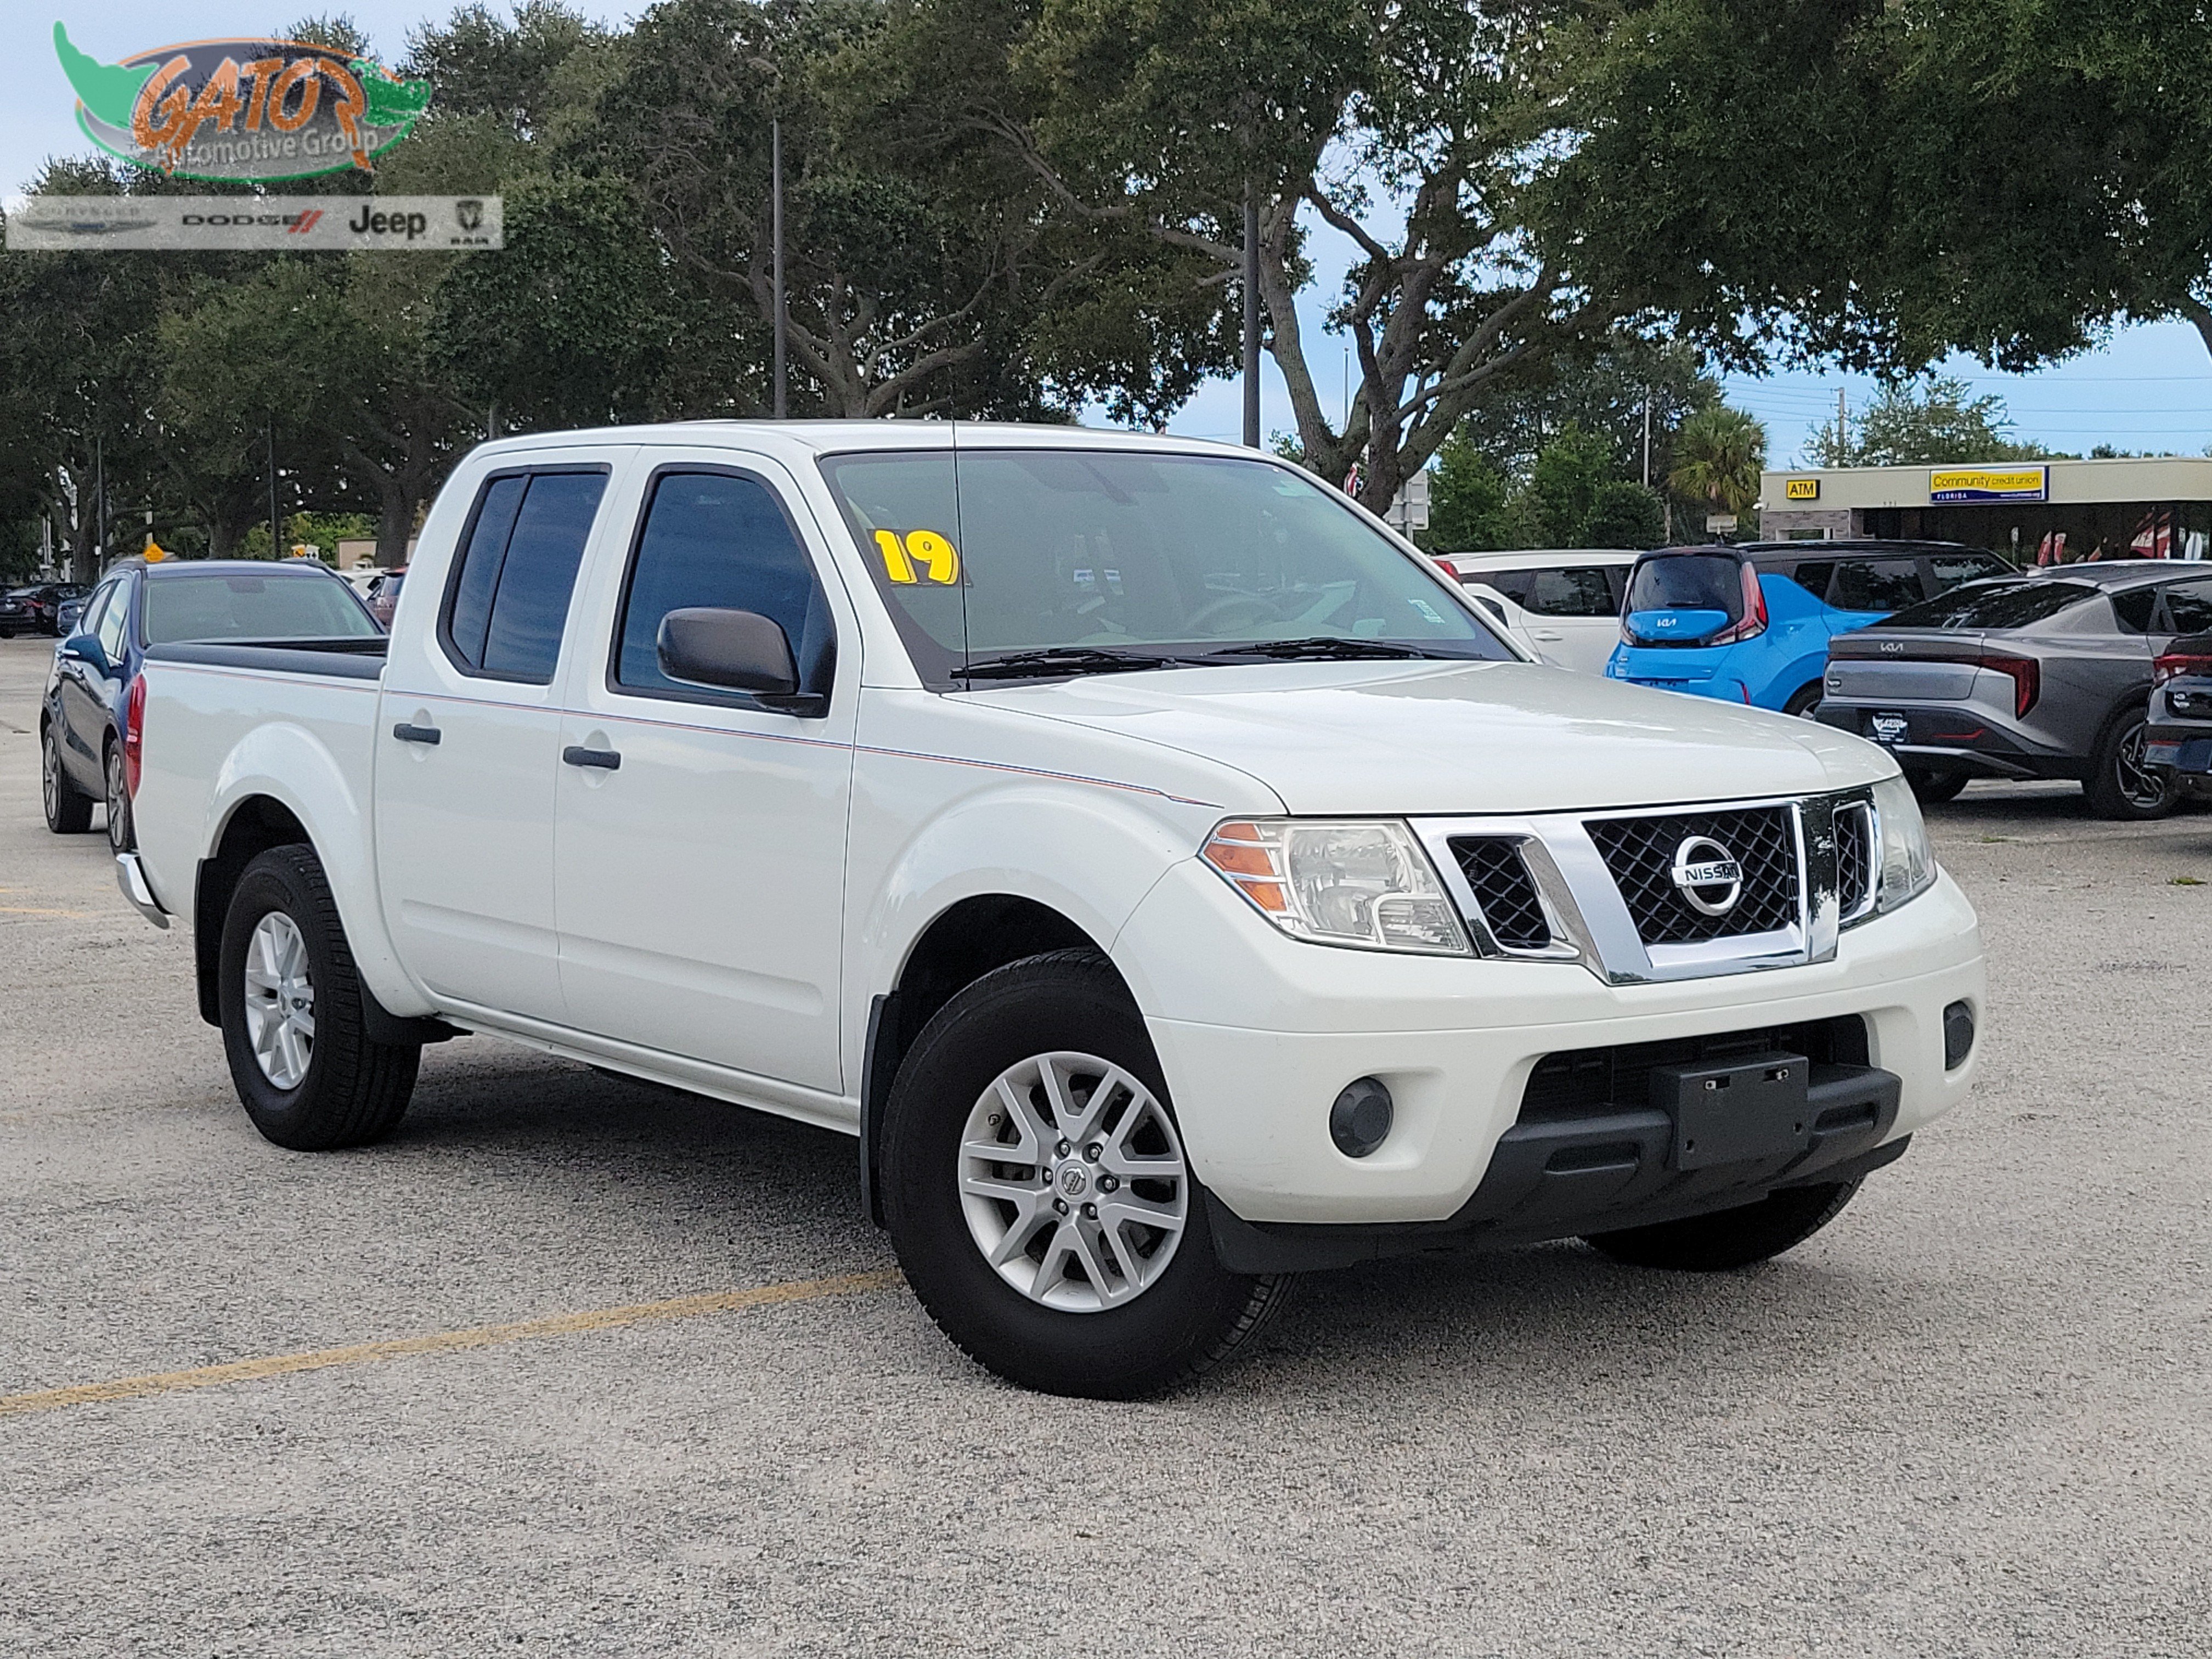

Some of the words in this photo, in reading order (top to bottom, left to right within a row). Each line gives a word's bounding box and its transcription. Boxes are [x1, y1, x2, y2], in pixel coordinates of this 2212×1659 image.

[1934, 475, 1990, 488] Community
[1991, 476, 2015, 485] credit
[2016, 476, 2039, 484] union
[1790, 483, 1814, 496] ATM
[875, 529, 959, 585] 19
[1685, 864, 1740, 882] NISSAN
